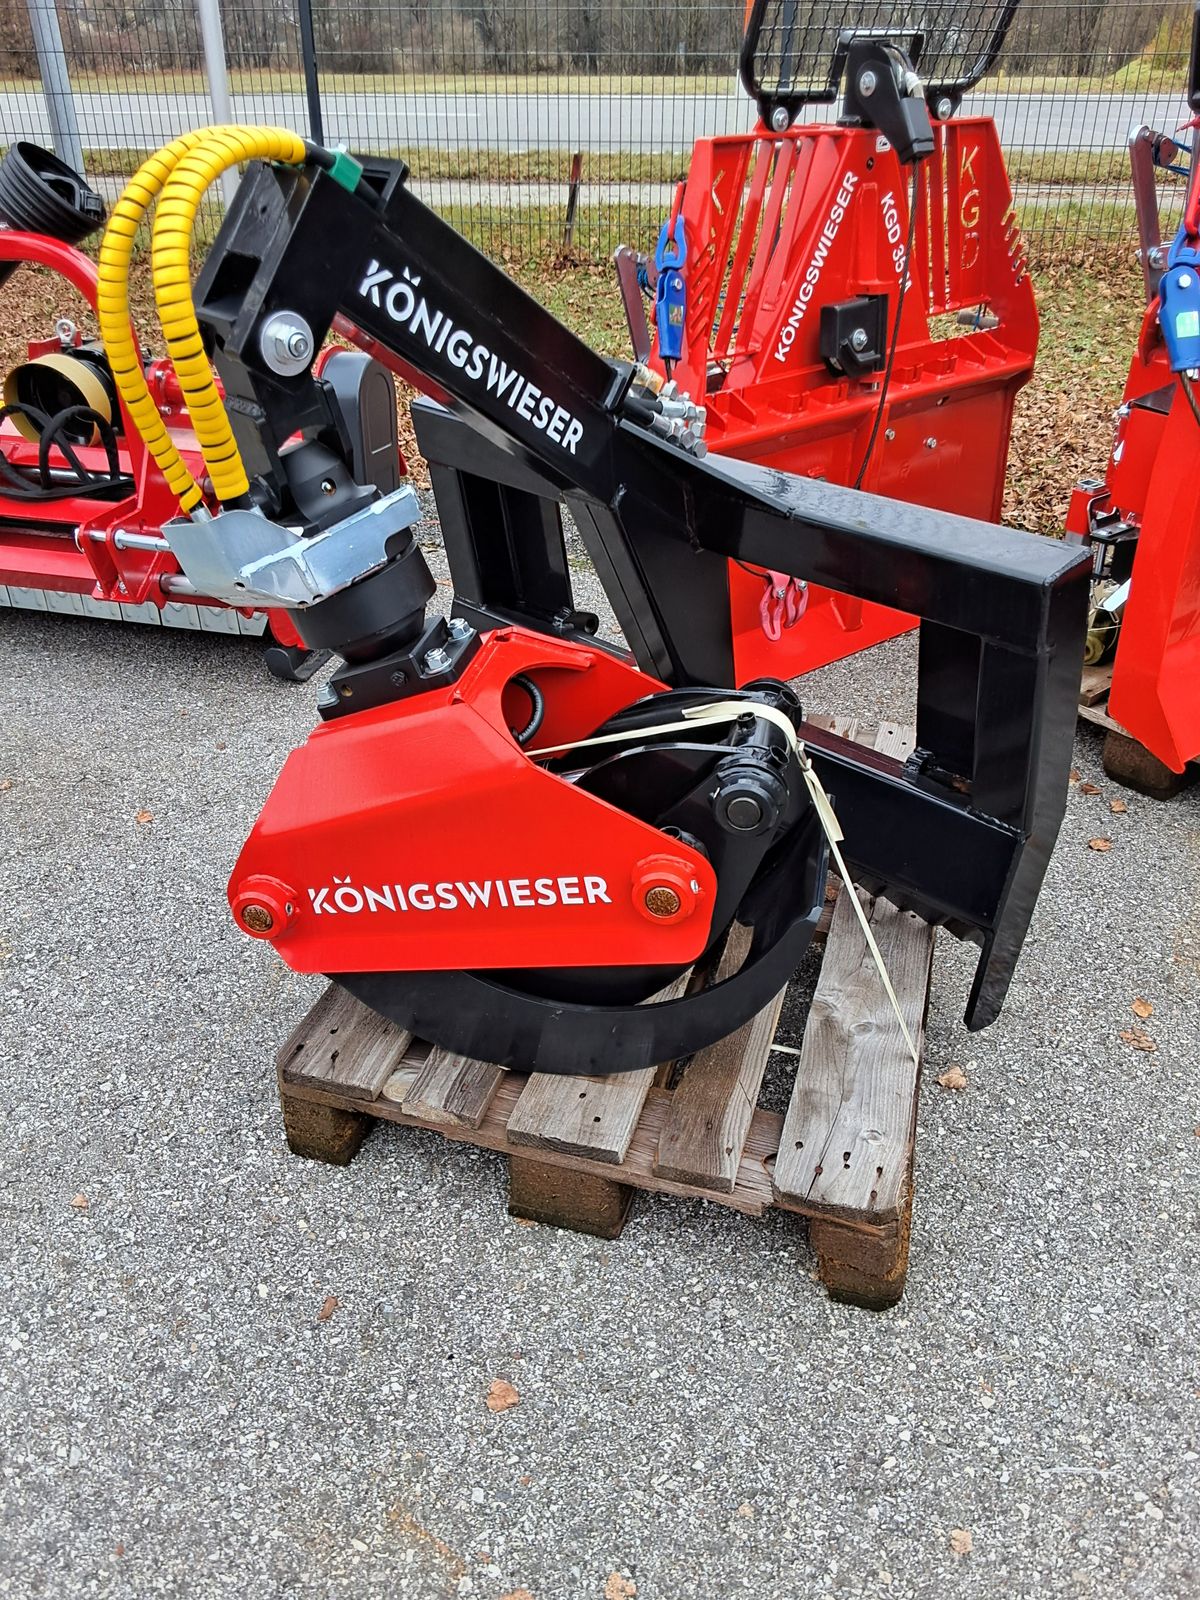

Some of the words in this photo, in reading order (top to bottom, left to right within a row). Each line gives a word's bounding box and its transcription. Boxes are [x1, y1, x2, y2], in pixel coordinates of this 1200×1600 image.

[774, 171, 859, 362] KÖNIGSWIESER
[881, 191, 901, 244] KGD
[960, 145, 980, 270] KGD
[359, 259, 584, 455] KÖNIGSWIESER
[307, 875, 612, 914] KÖNIGSWIESER
